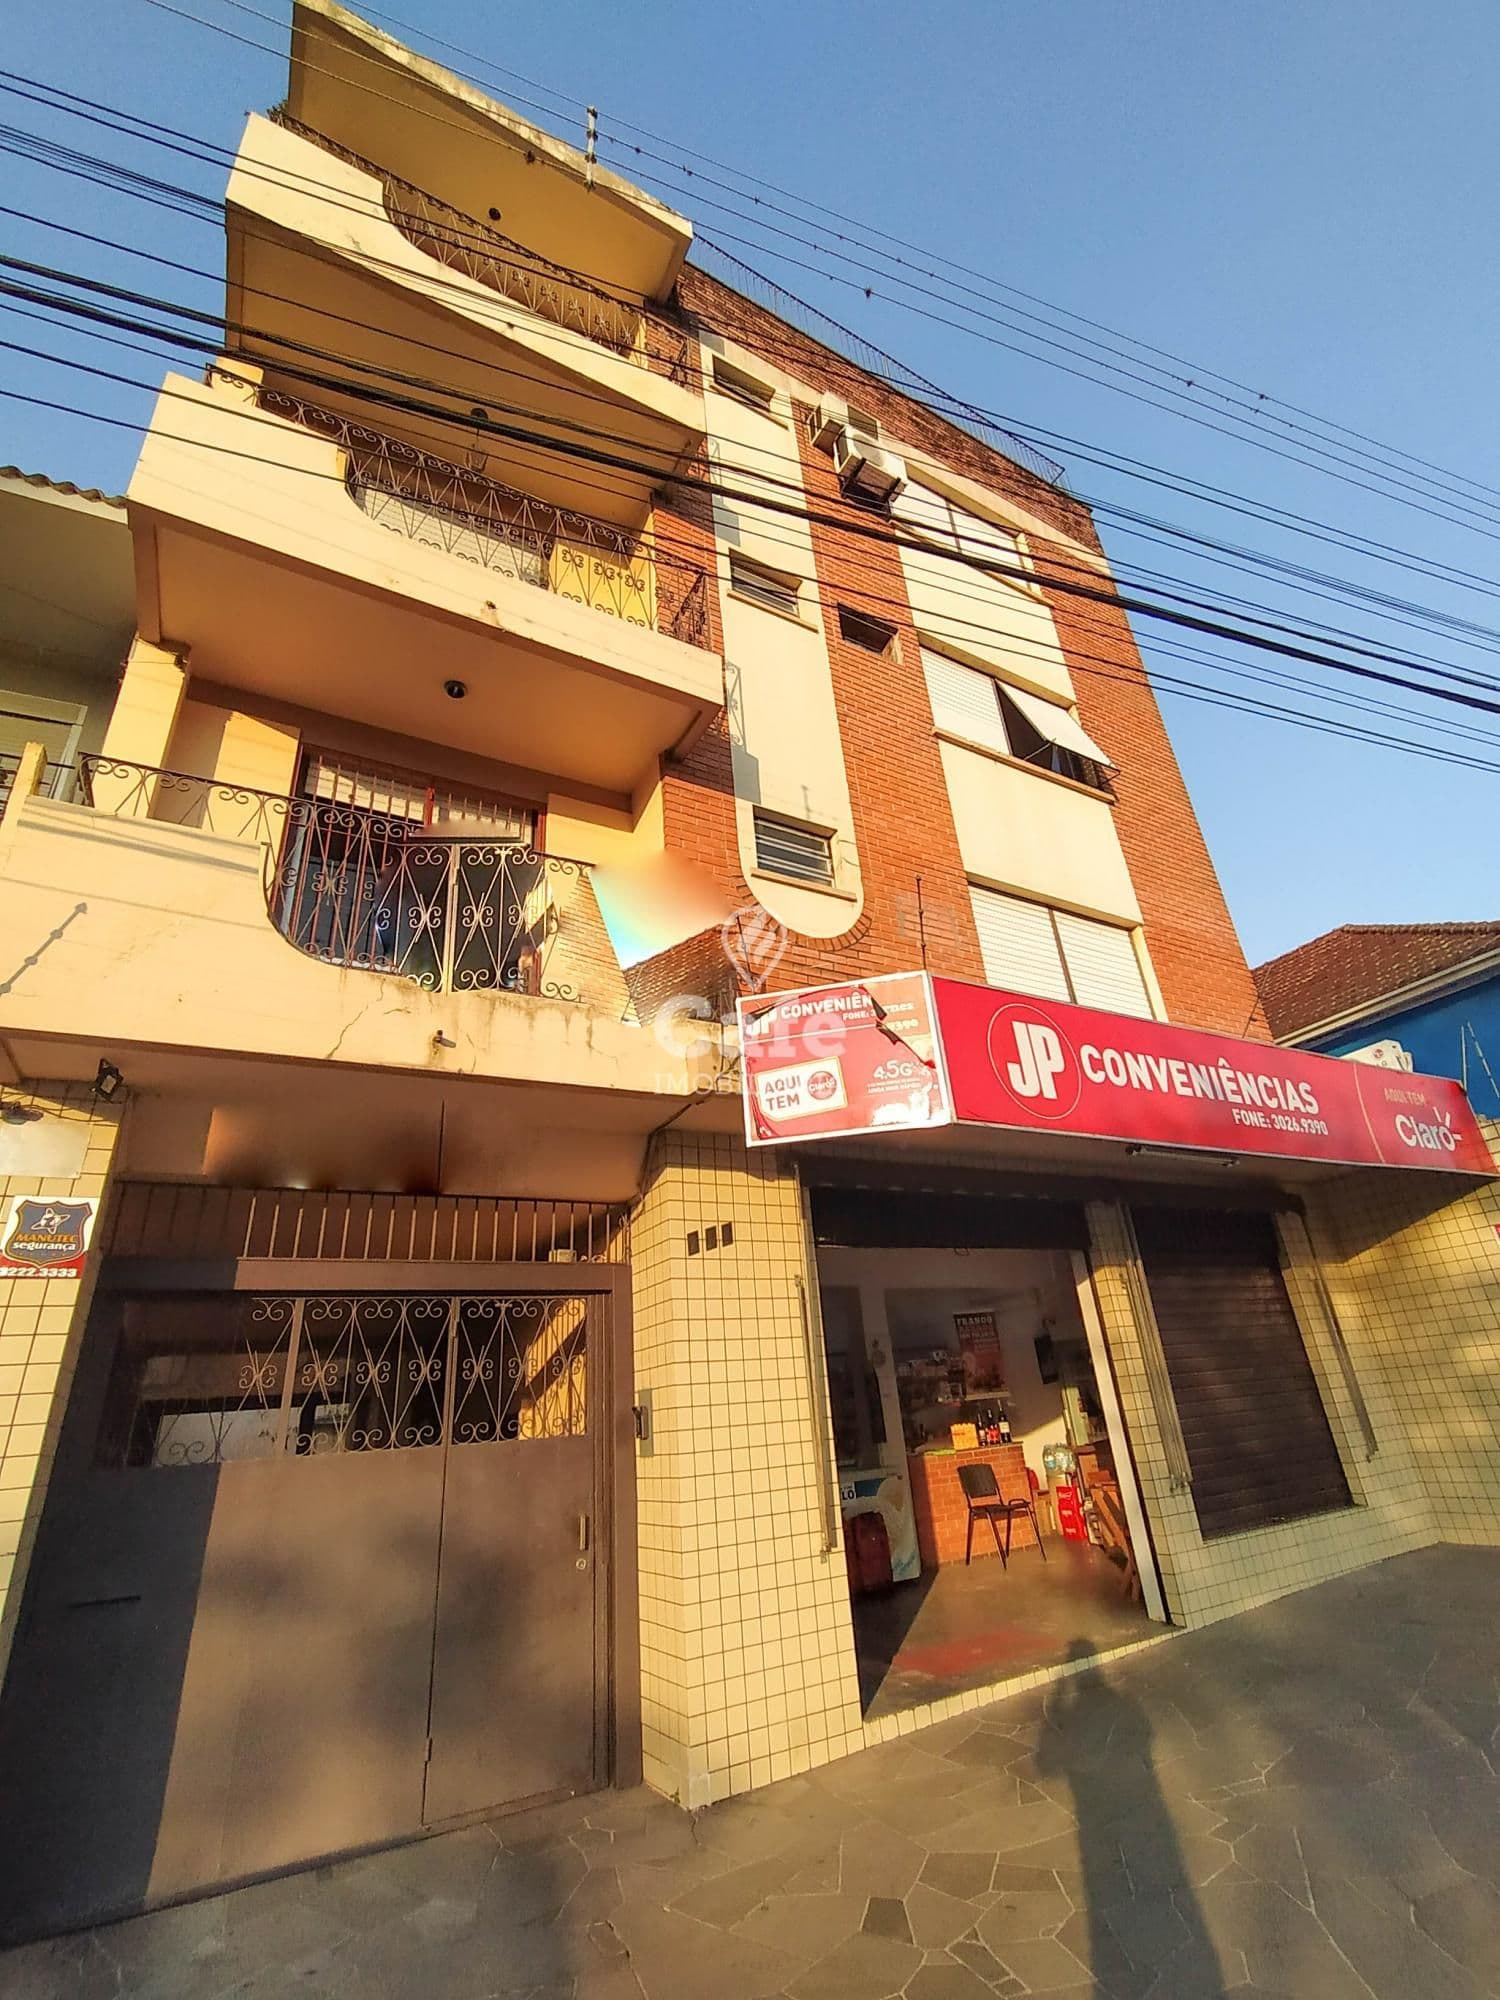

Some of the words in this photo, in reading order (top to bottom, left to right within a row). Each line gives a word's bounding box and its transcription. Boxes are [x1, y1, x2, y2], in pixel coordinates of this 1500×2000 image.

[1007, 1020, 1065, 1100] JP
[764, 1075, 801, 1095] AQUI
[1079, 1044, 1319, 1115] CONVENIÊNCIAS
[766, 1093, 801, 1111] TEM
[1406, 1091, 1426, 1107] TEM
[1232, 1108, 1271, 1129] FONE:
[1272, 1115, 1329, 1136] 3026.9390
[1395, 1111, 1457, 1152] Claro
[12, 1242, 76, 1251] segurança
